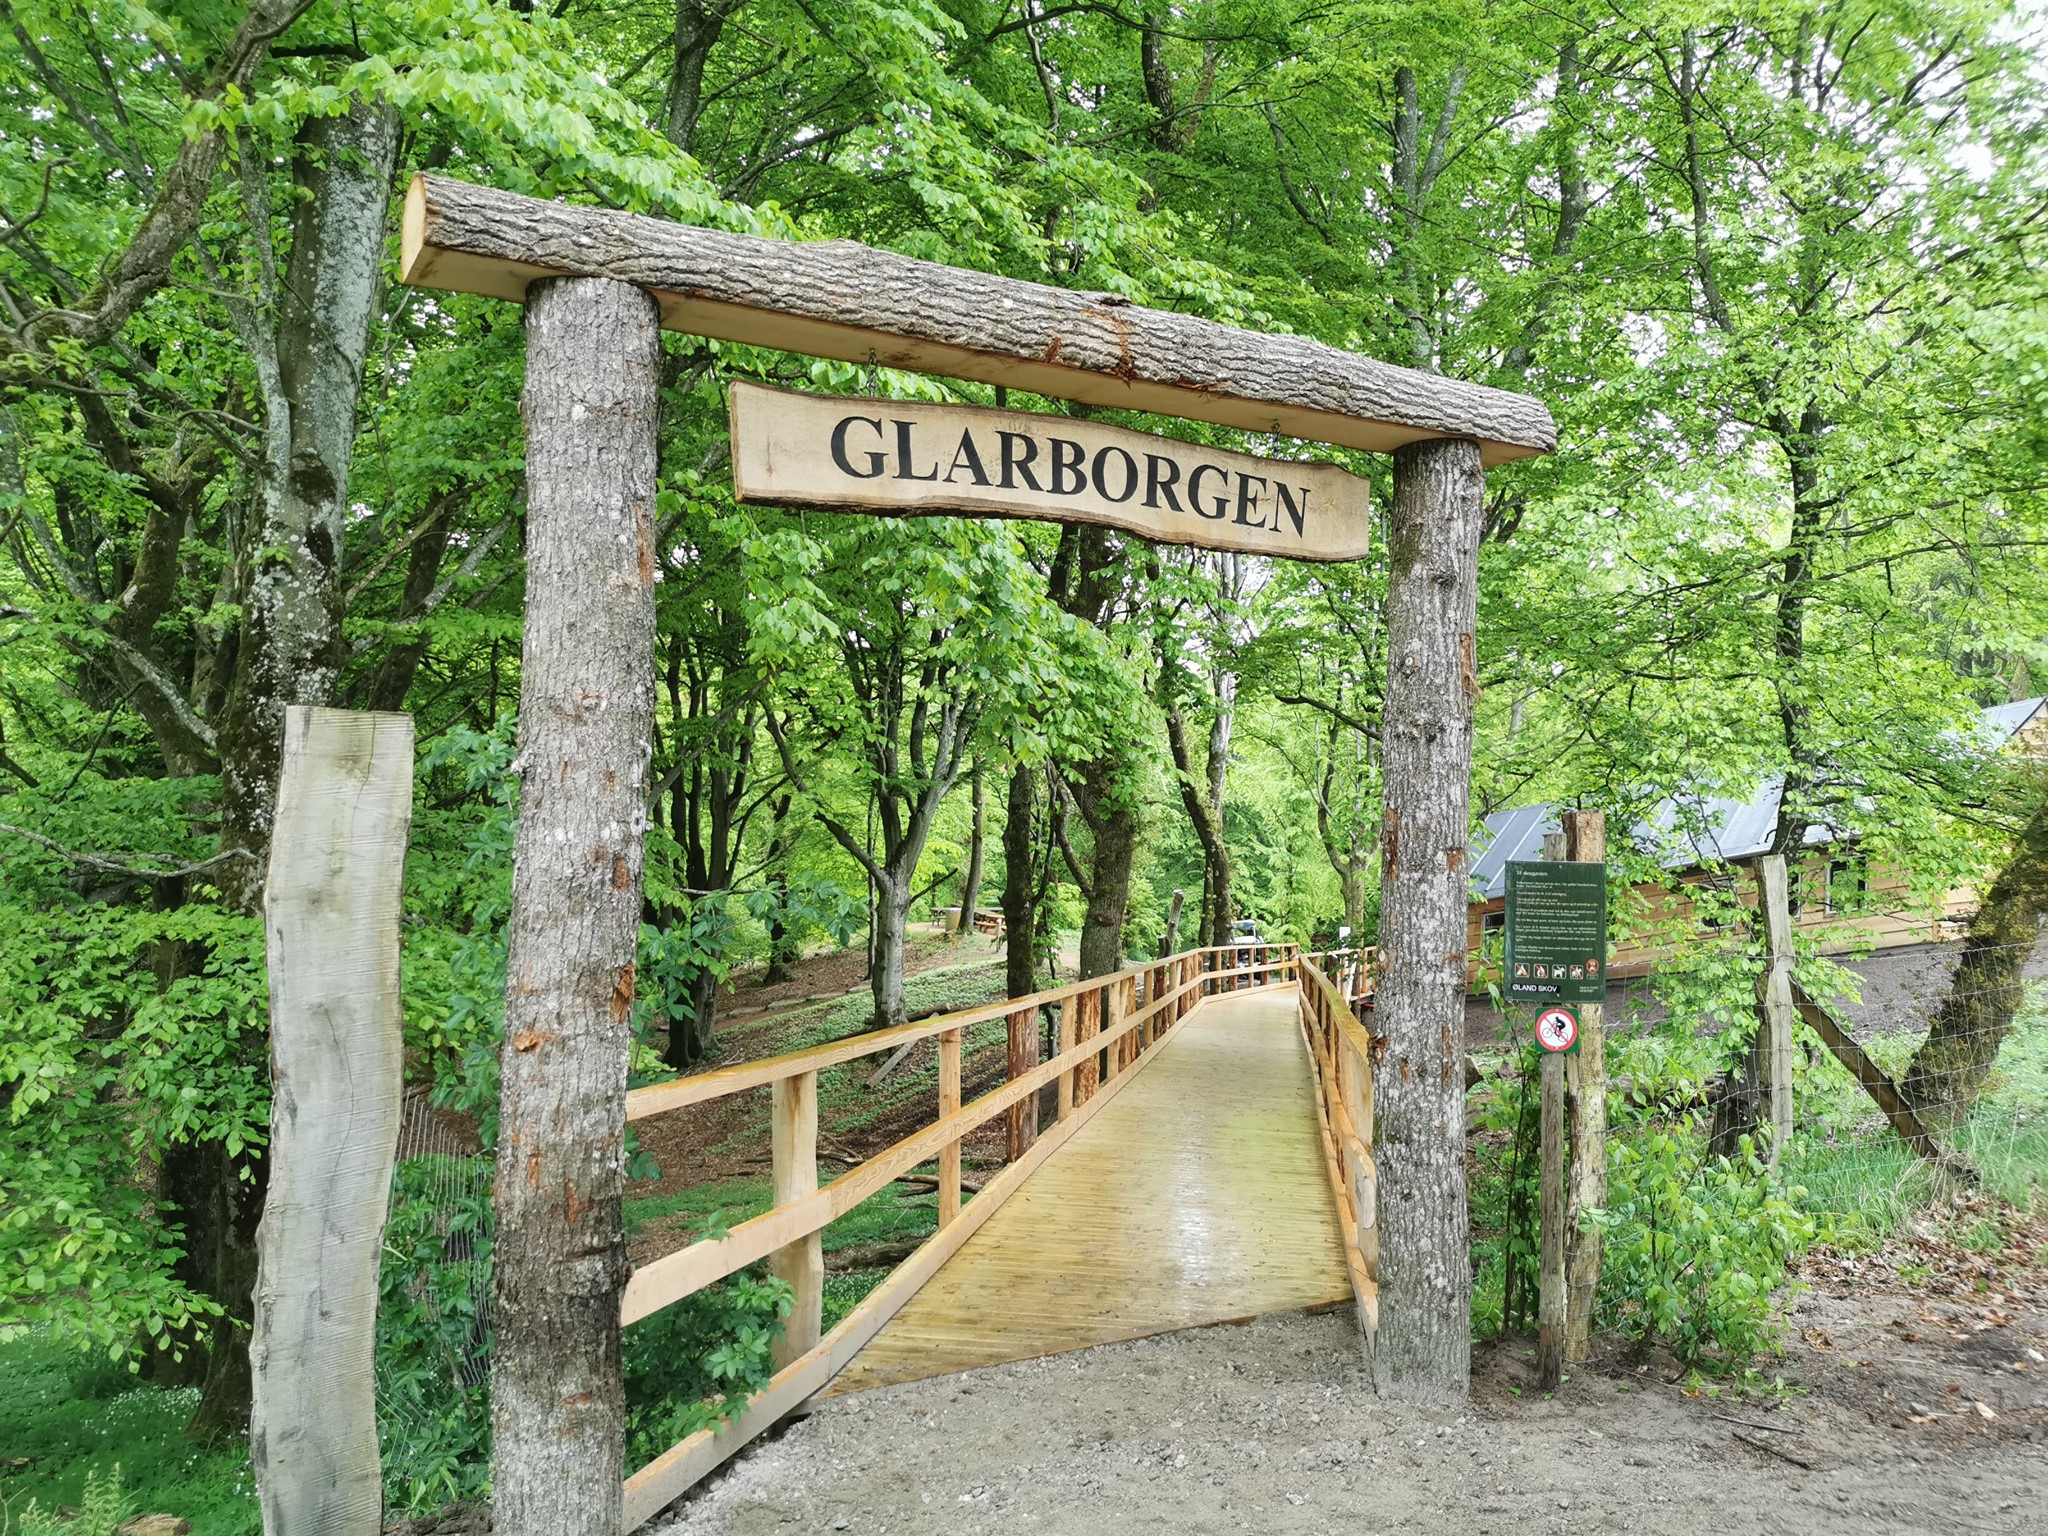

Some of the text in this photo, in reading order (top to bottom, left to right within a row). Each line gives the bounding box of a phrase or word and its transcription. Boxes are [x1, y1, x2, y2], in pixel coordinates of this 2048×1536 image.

[830, 416, 1312, 539] GLARBORGEN
[1512, 983, 1558, 992] ØLAND SKOV
